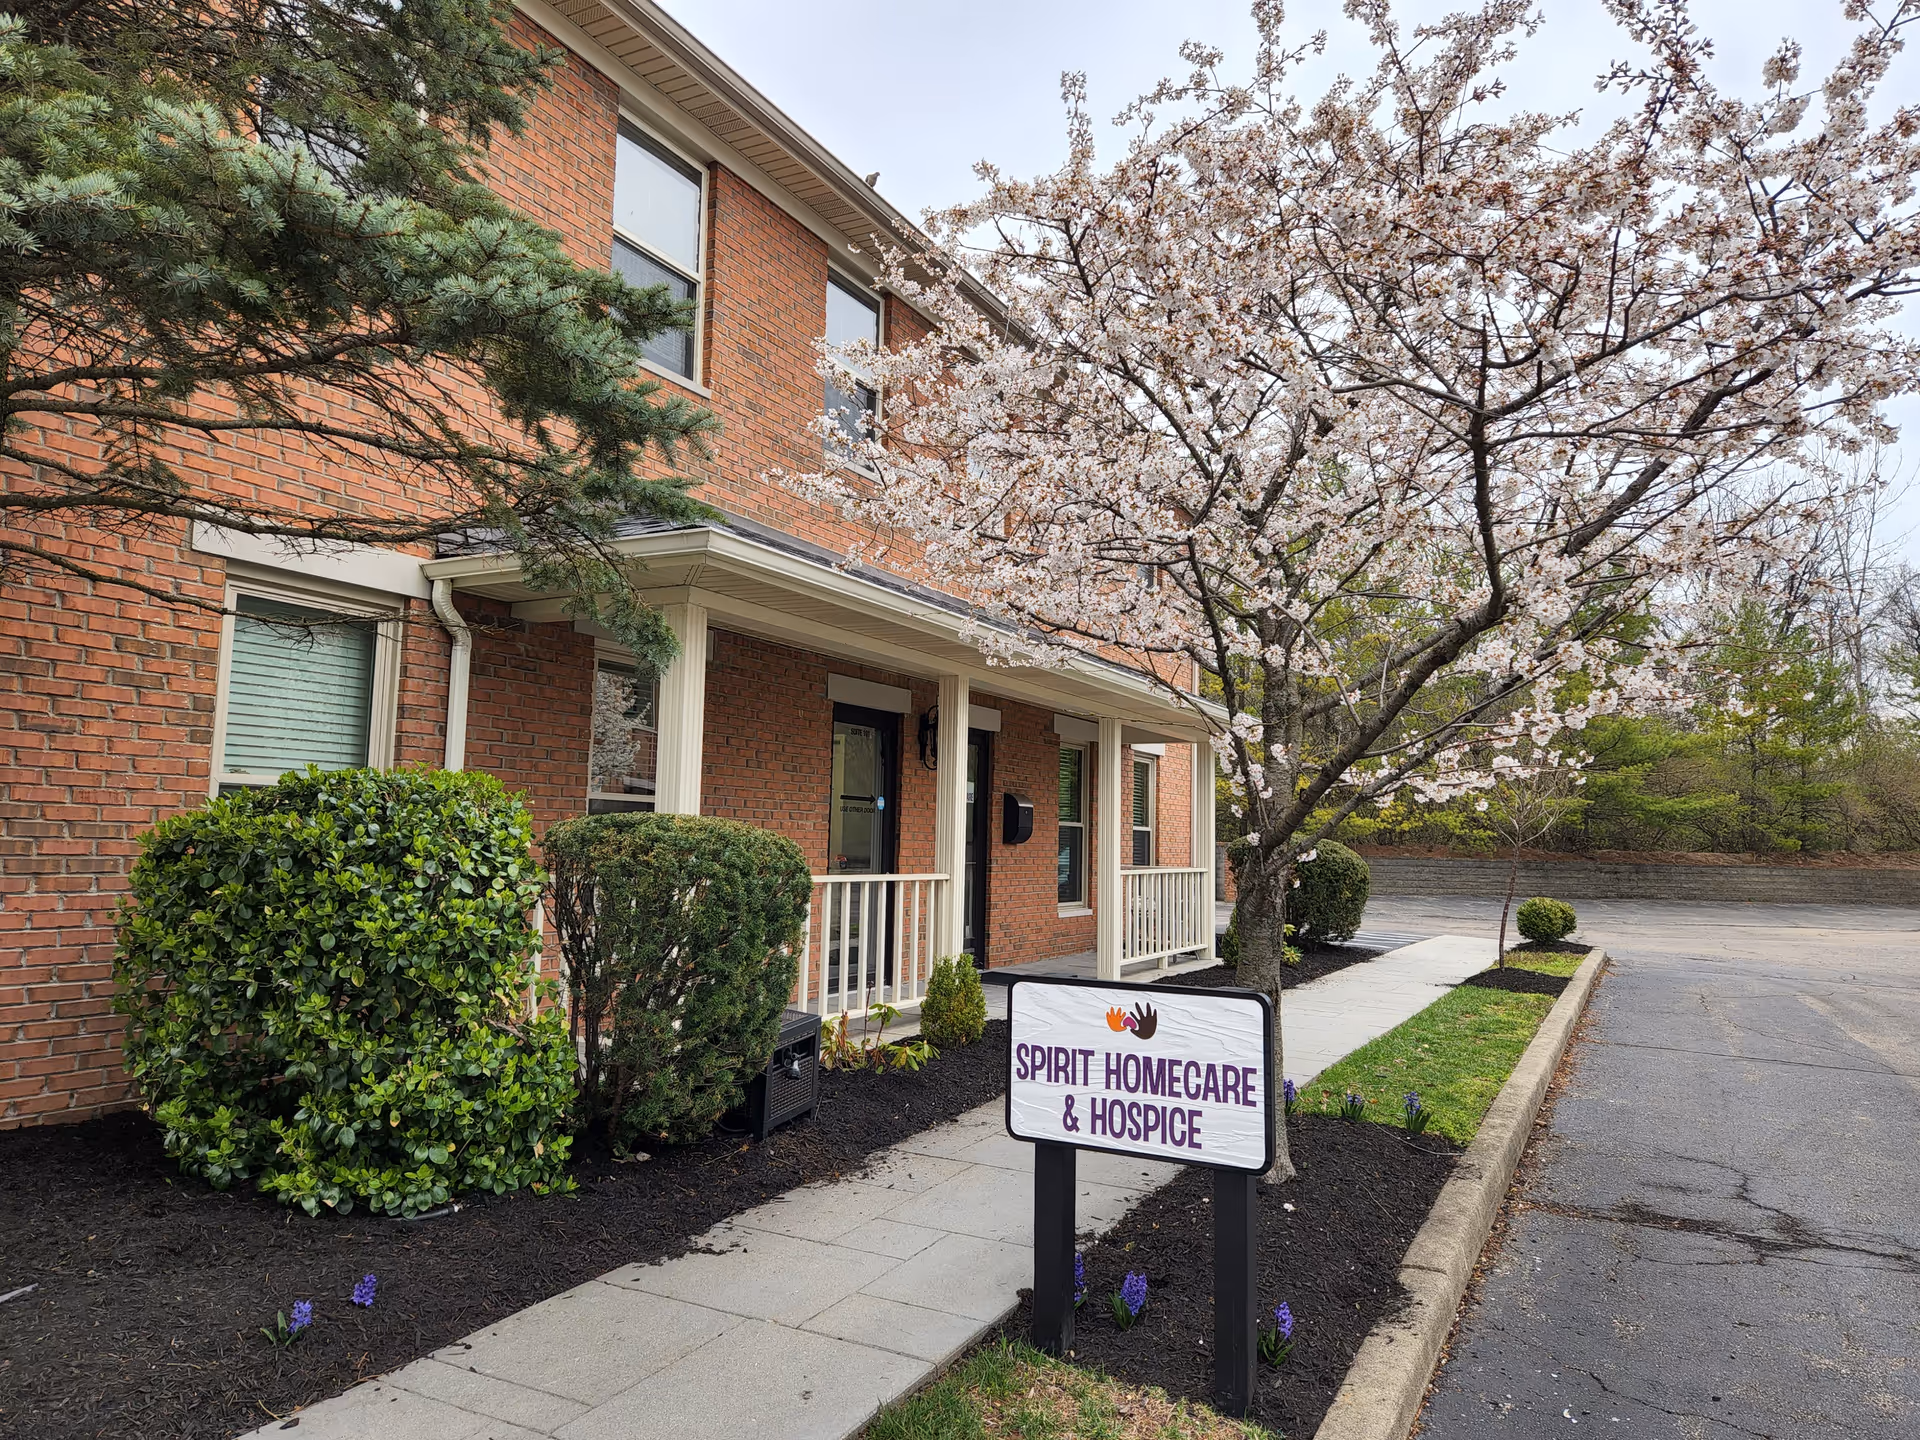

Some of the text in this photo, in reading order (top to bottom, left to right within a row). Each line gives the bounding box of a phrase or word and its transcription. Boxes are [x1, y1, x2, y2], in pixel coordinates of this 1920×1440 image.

[840, 805, 849, 813] USE
[1016, 1042, 1258, 1108] SPIRIT HOMECARE
[1062, 1094, 1203, 1150] & HOSPICE
